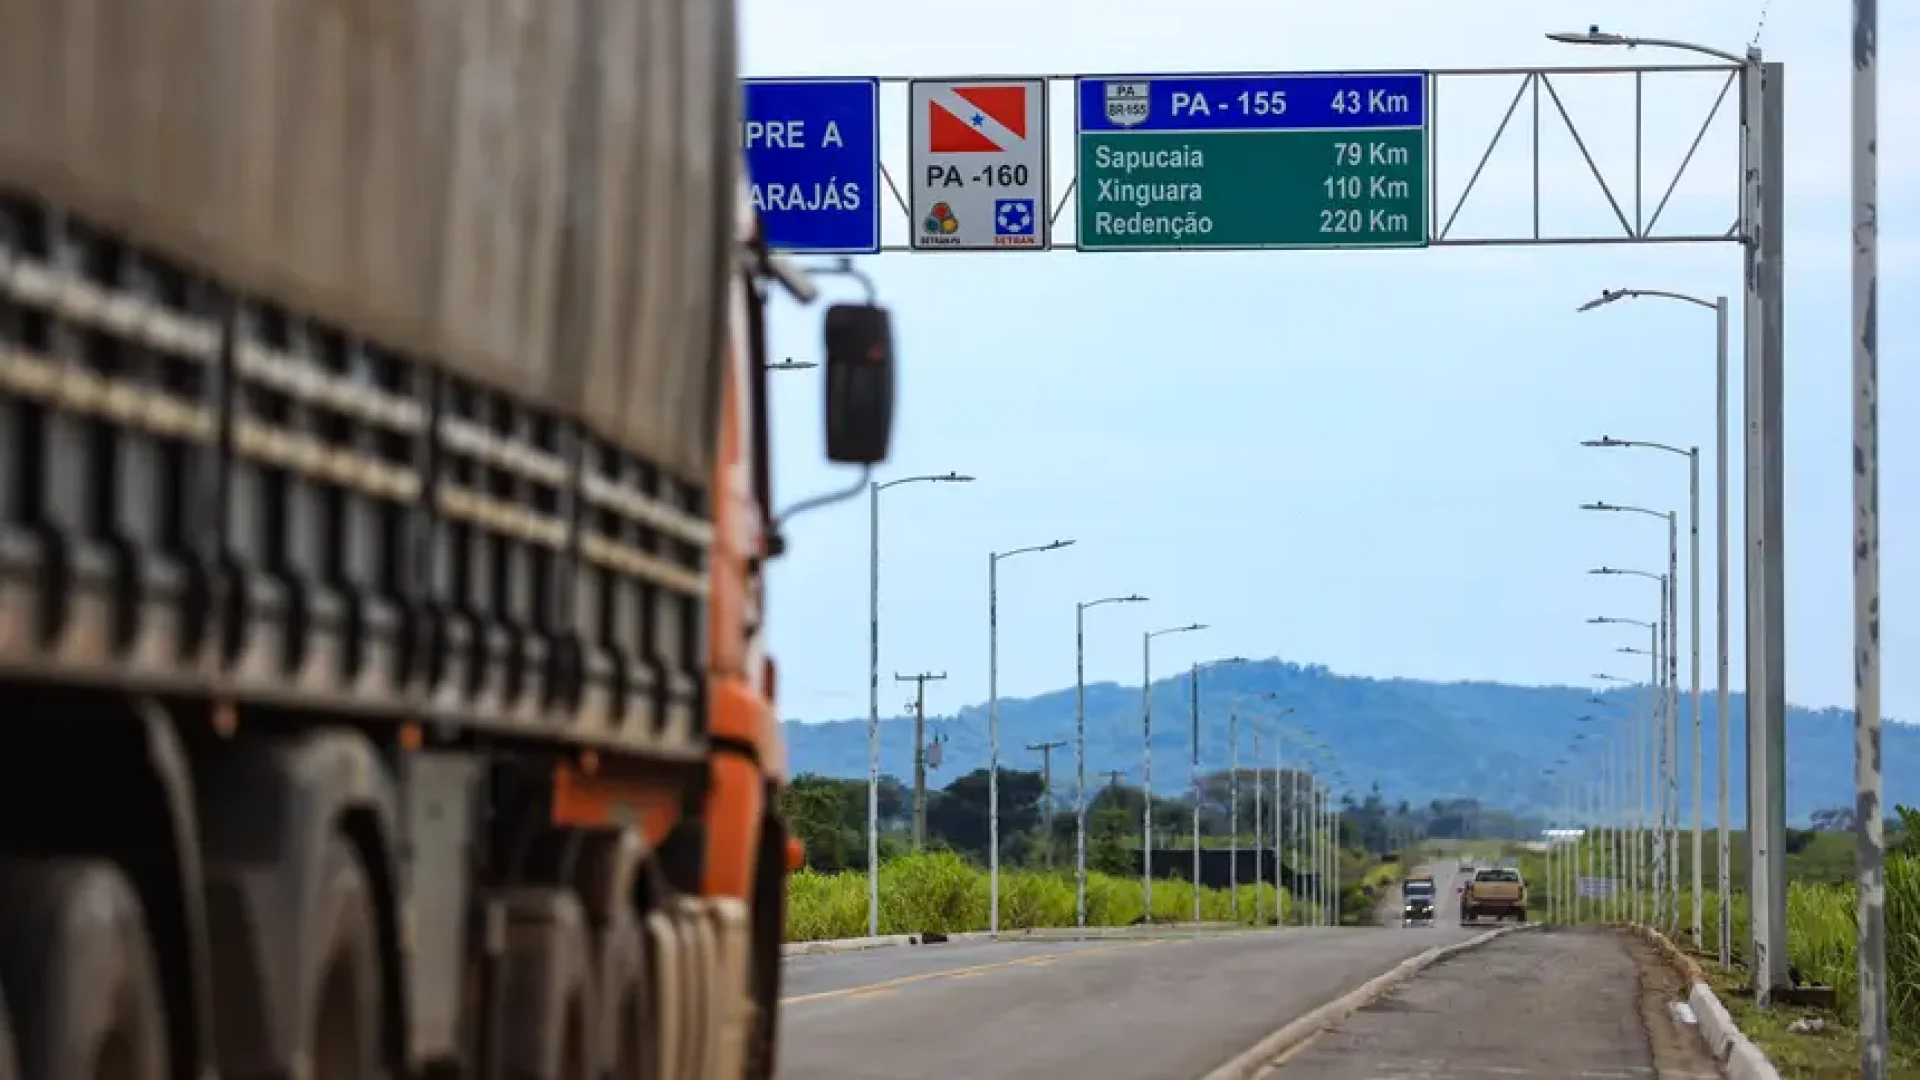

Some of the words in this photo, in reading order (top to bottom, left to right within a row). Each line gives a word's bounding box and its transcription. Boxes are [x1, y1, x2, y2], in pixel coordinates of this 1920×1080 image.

[1115, 85, 1135, 97] PA
[1171, 91, 1211, 117] PA
[1237, 91, 1287, 115] 155
[1330, 90, 1361, 114] 43
[1368, 89, 1409, 114] Km
[739, 121, 805, 148] PRE
[821, 120, 843, 148] A
[1095, 145, 1204, 173] Sapucaia
[1334, 142, 1362, 167] 79
[1369, 142, 1408, 166] Km
[750, 176, 860, 211] ARAJÁS
[1098, 178, 1202, 207] Xinguara
[1323, 176, 1362, 200] 110
[1369, 176, 1409, 200] Km
[1095, 211, 1213, 239] Redenção
[1318, 209, 1362, 234] 220
[1369, 210, 1408, 234] Km
